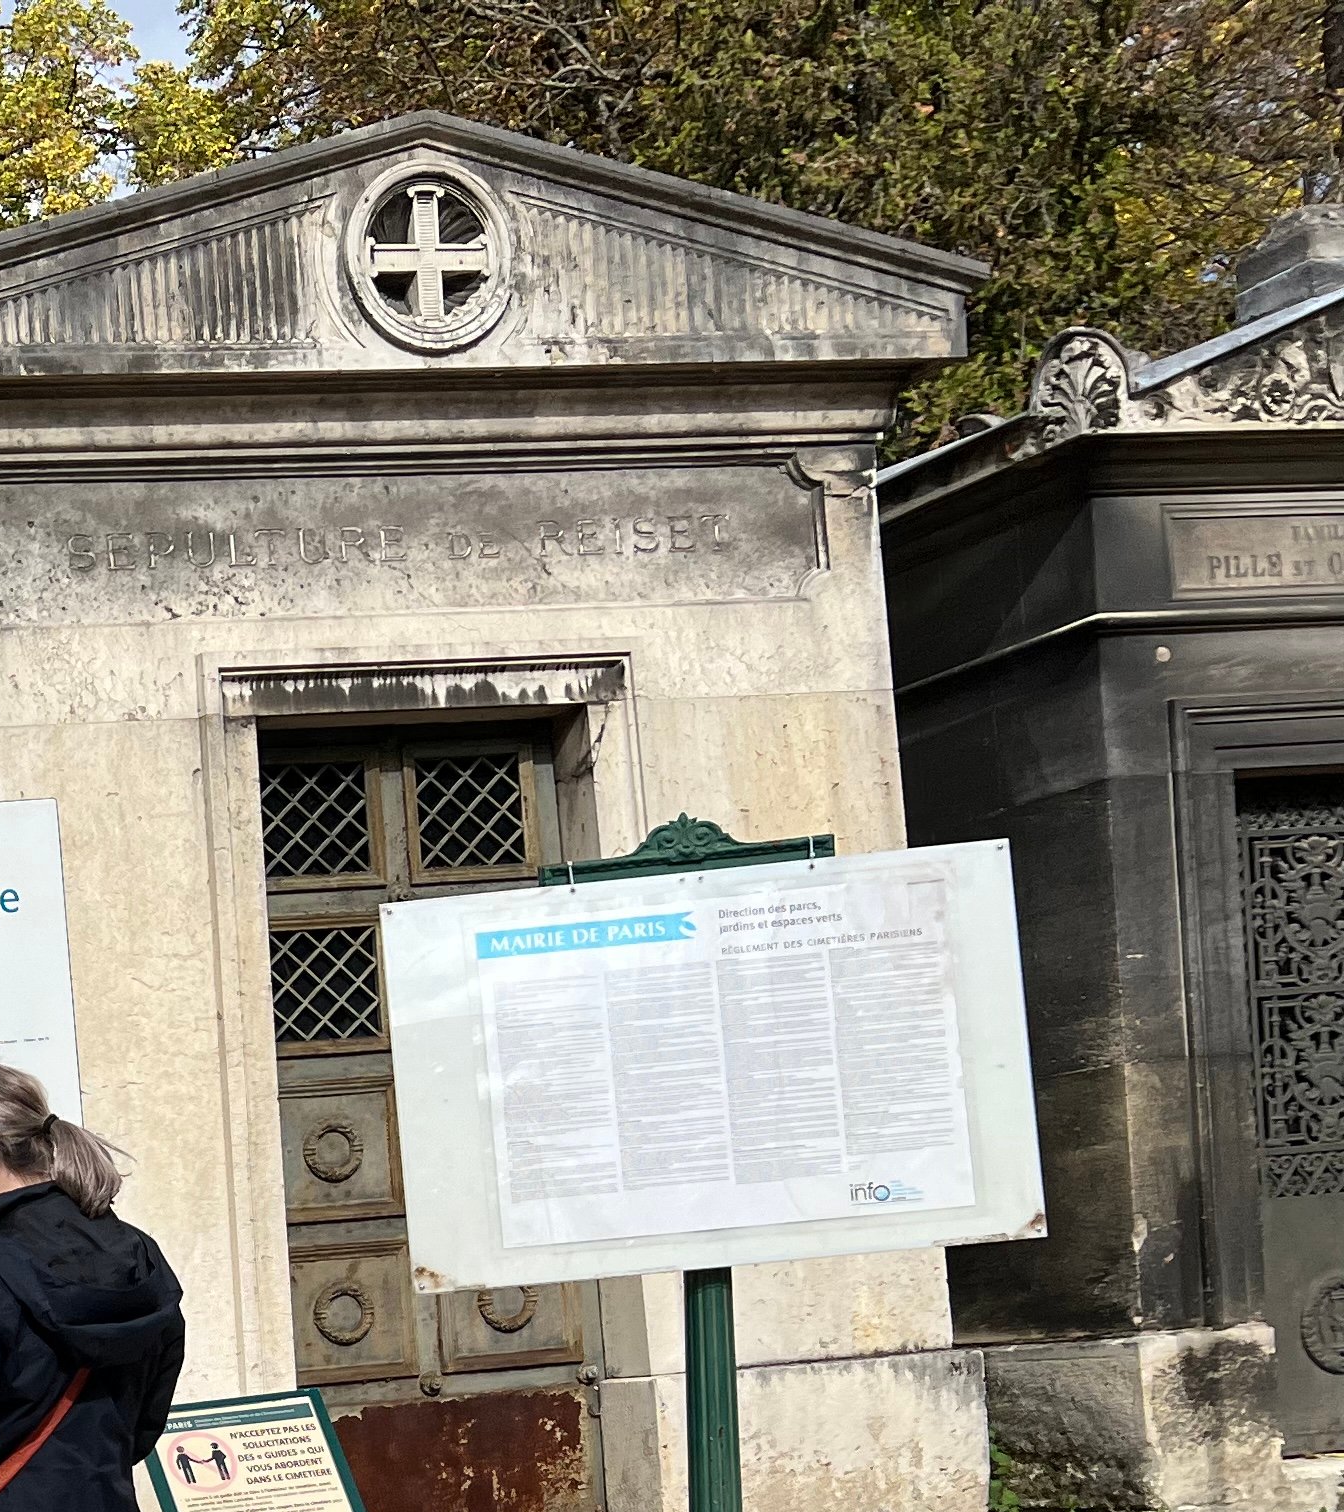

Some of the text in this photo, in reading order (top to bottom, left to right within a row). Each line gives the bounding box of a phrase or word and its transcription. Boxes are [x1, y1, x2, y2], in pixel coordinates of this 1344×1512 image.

[66, 514, 730, 572] SEPULTURE DE REISET
[718, 907, 765, 919] Direction
[768, 904, 787, 915] des
[719, 921, 756, 935] jardins
[771, 916, 814, 930] espaces
[816, 912, 843, 925] verts
[490, 921, 667, 953] MAIRIE DE PARIS
[783, 939, 803, 950] DES
[283, 1424, 300, 1435] PAS
[301, 1423, 317, 1433] LES
[265, 1448, 298, 1459] GUIDES
[307, 1446, 325, 1455] QUI
[246, 1457, 323, 1473] VOUS ABORDENT
[246, 1475, 272, 1485] DANS
[274, 1473, 284, 1482] LE
